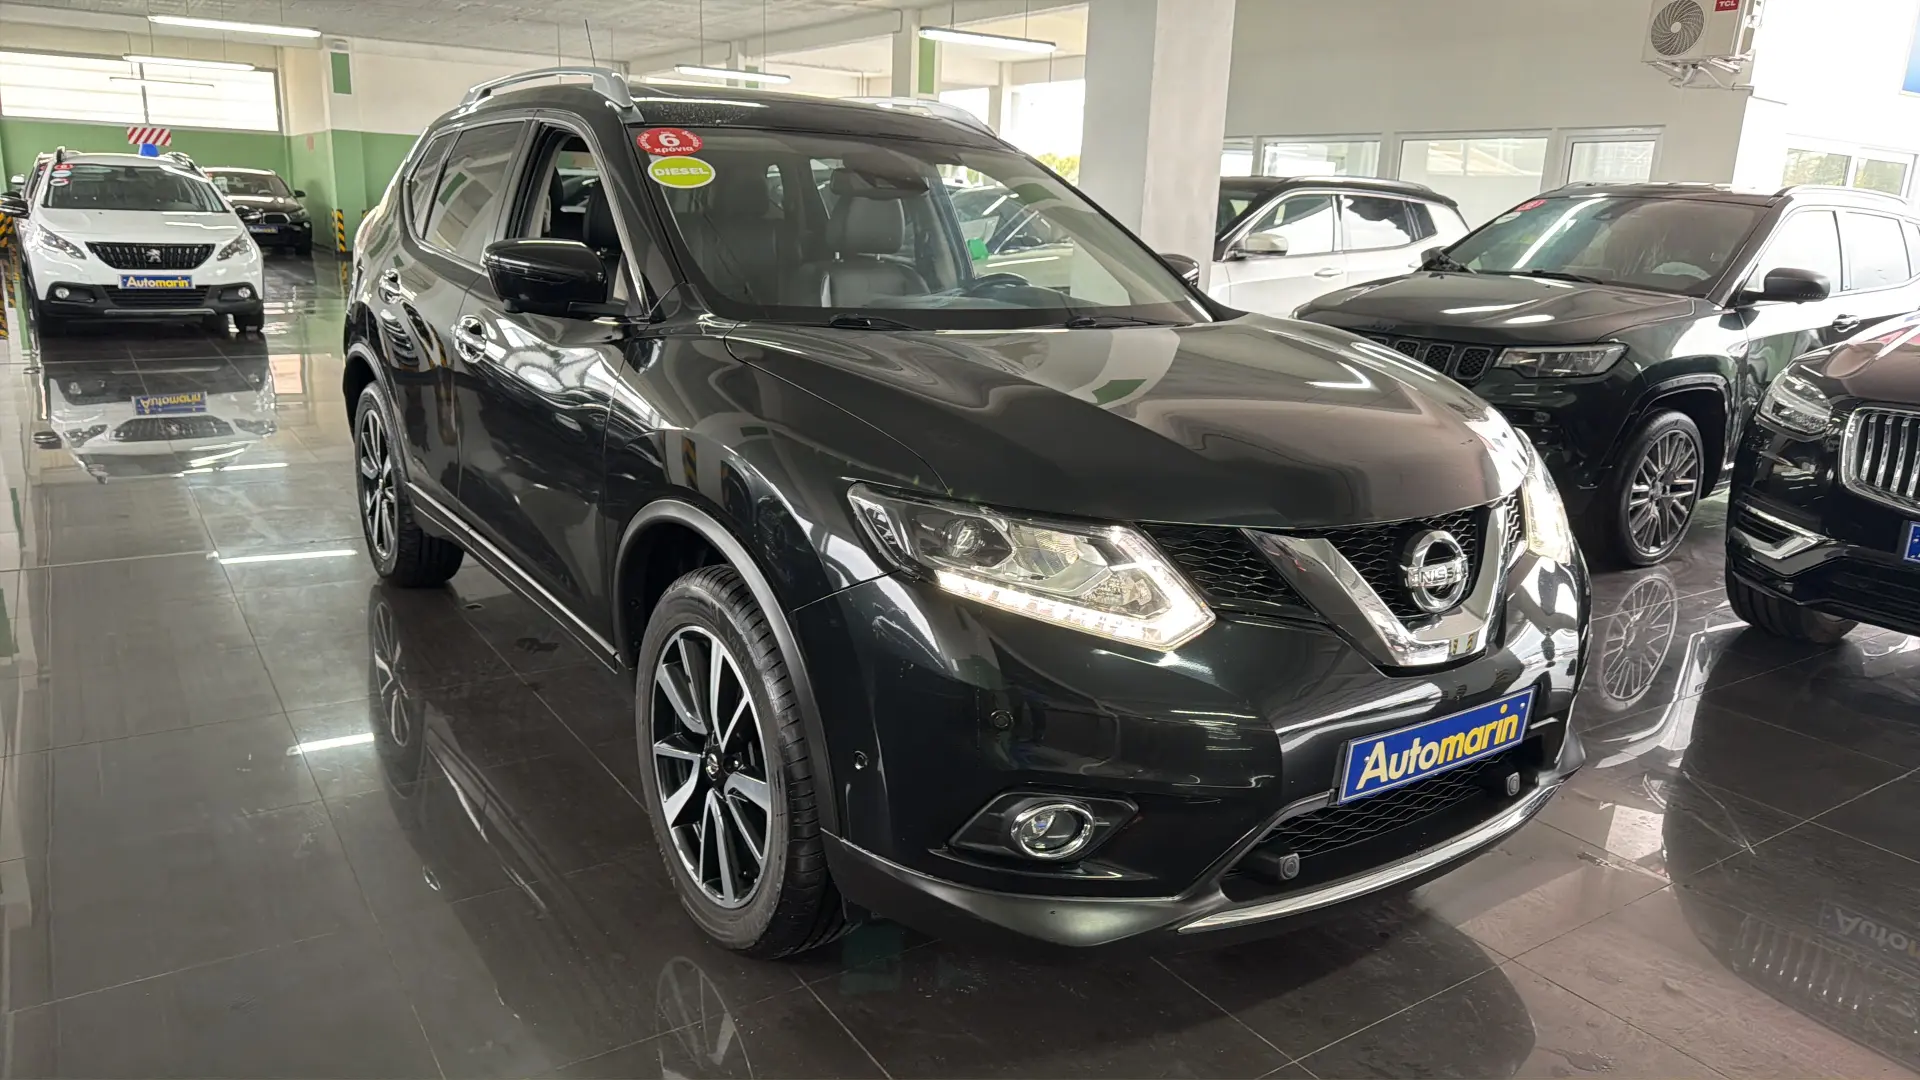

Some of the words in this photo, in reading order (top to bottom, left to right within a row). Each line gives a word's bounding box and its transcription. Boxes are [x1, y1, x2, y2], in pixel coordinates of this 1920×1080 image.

[658, 133, 680, 147] 6
[654, 167, 709, 176] DIESEL
[126, 275, 189, 288] Automarin
[1355, 703, 1519, 790] Automarin
